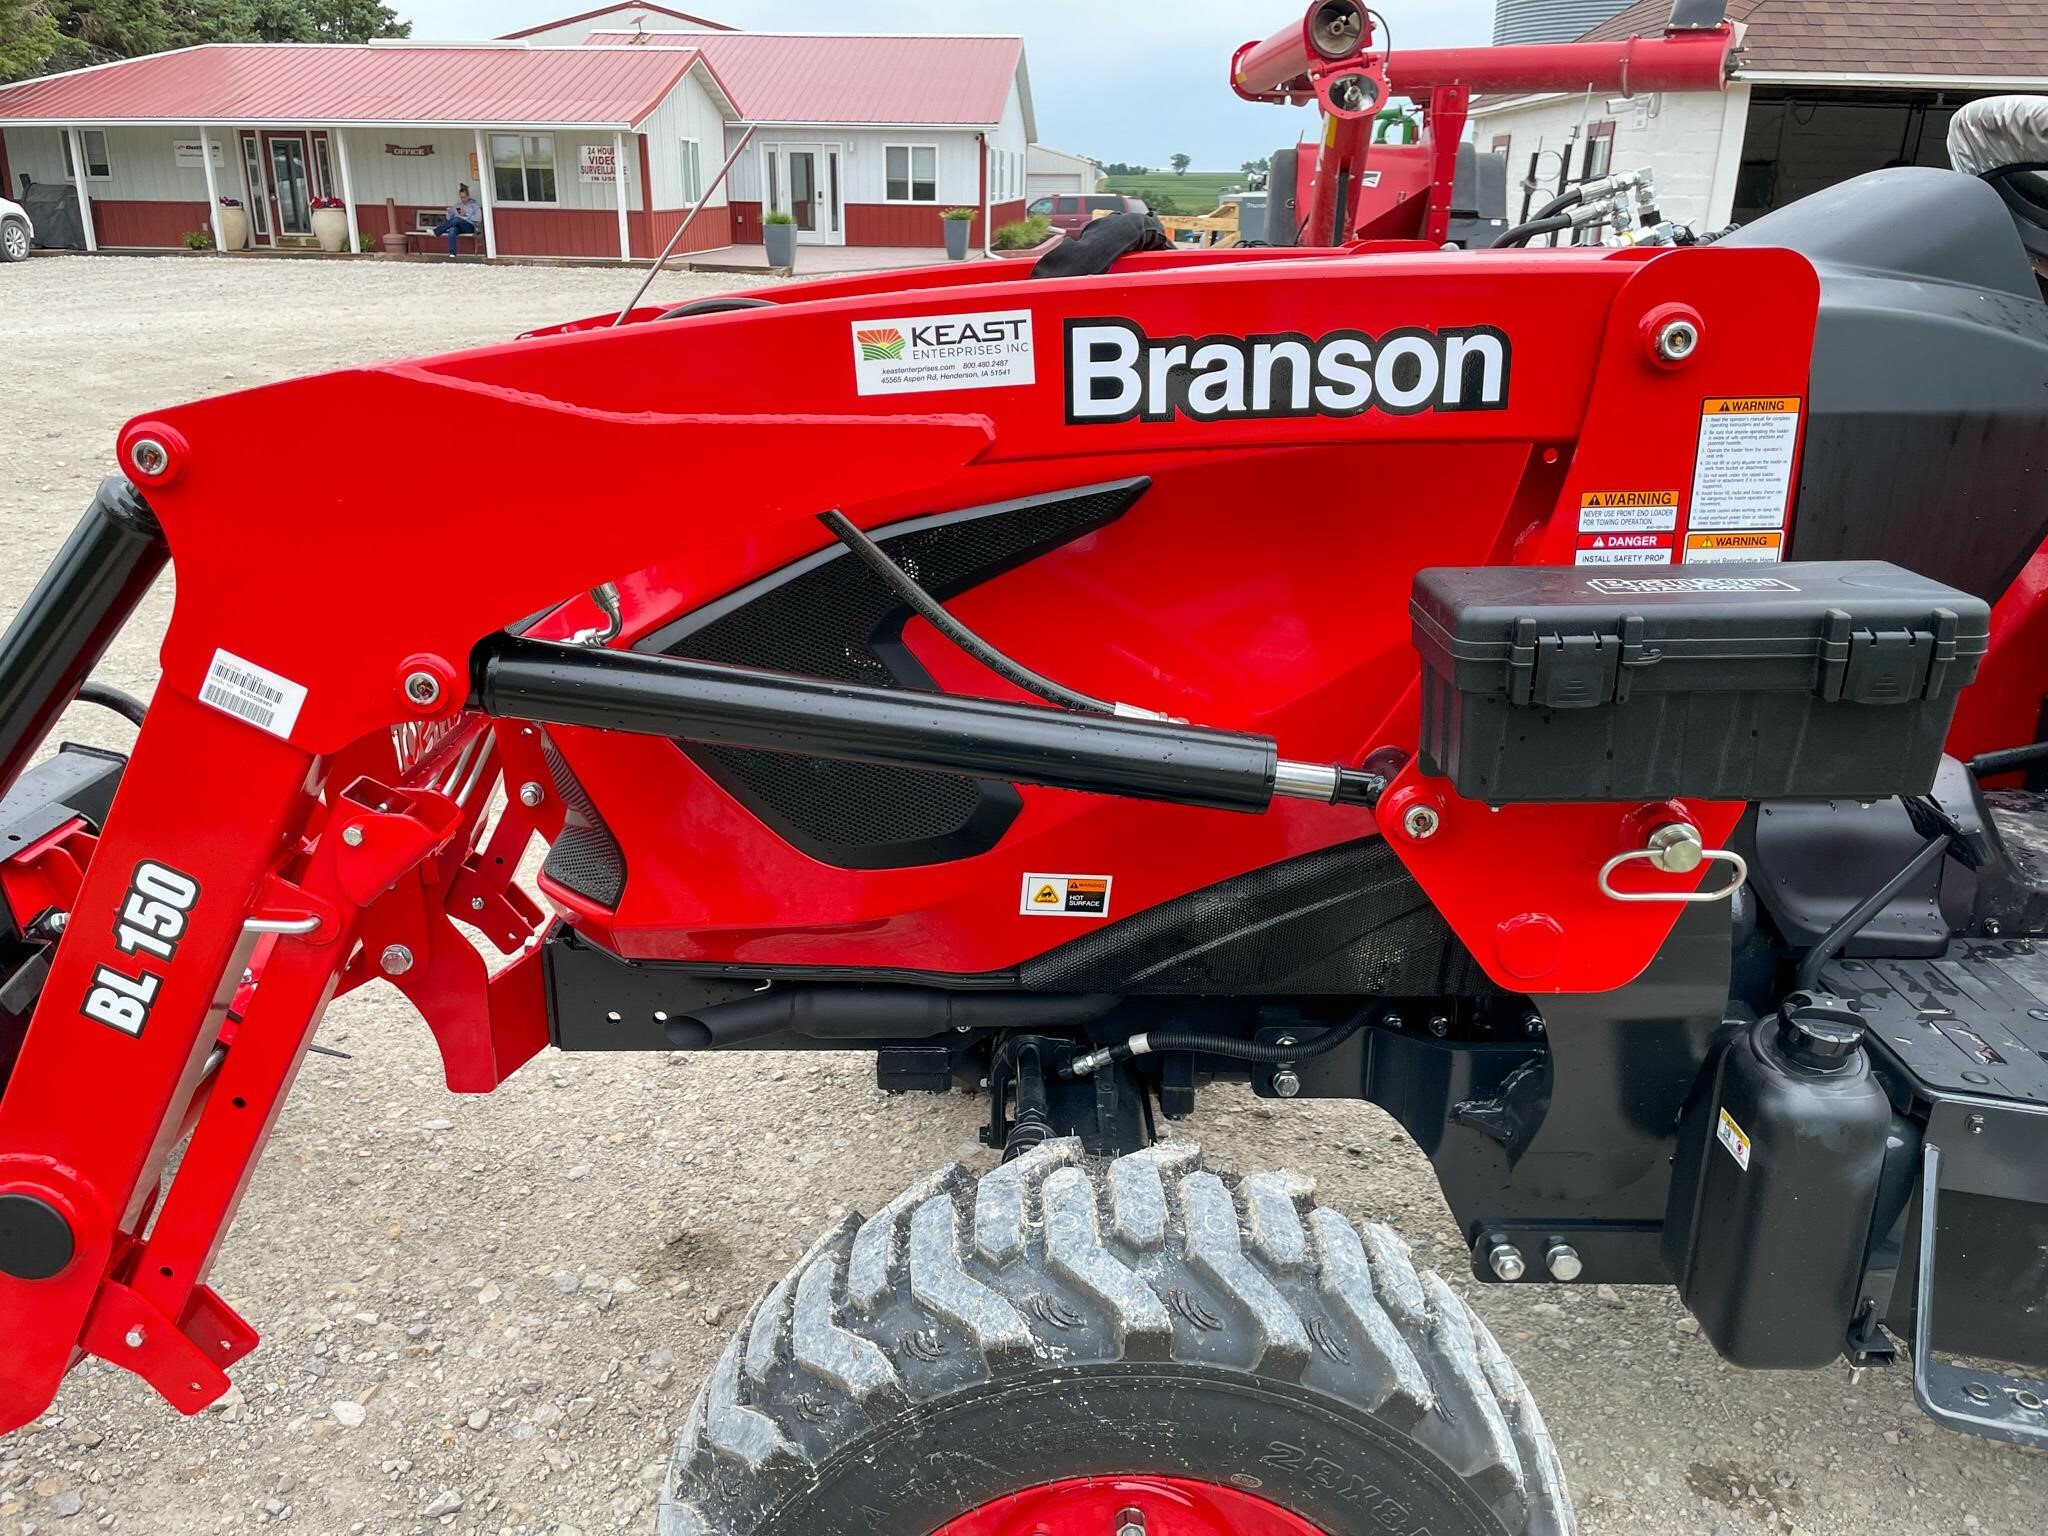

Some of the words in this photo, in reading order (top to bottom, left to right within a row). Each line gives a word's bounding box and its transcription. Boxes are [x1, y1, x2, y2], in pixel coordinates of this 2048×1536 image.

[912, 319, 1027, 347] KEAST
[913, 346, 1001, 359] ENTERPRISES
[1007, 343, 1029, 353] INC
[882, 363, 955, 375] keastenterprises.com
[963, 360, 1008, 369] 800.480.2487
[1070, 324, 1504, 418] Branson
[904, 375, 924, 383] Aspen
[940, 371, 979, 380] Henderson,
[1733, 401, 1784, 411] WARNING
[1605, 492, 1671, 505] WARNING
[1608, 536, 1657, 546] DANGER
[1716, 537, 1767, 546] WARNING
[118, 863, 197, 956] 150
[84, 969, 158, 1034] BL
